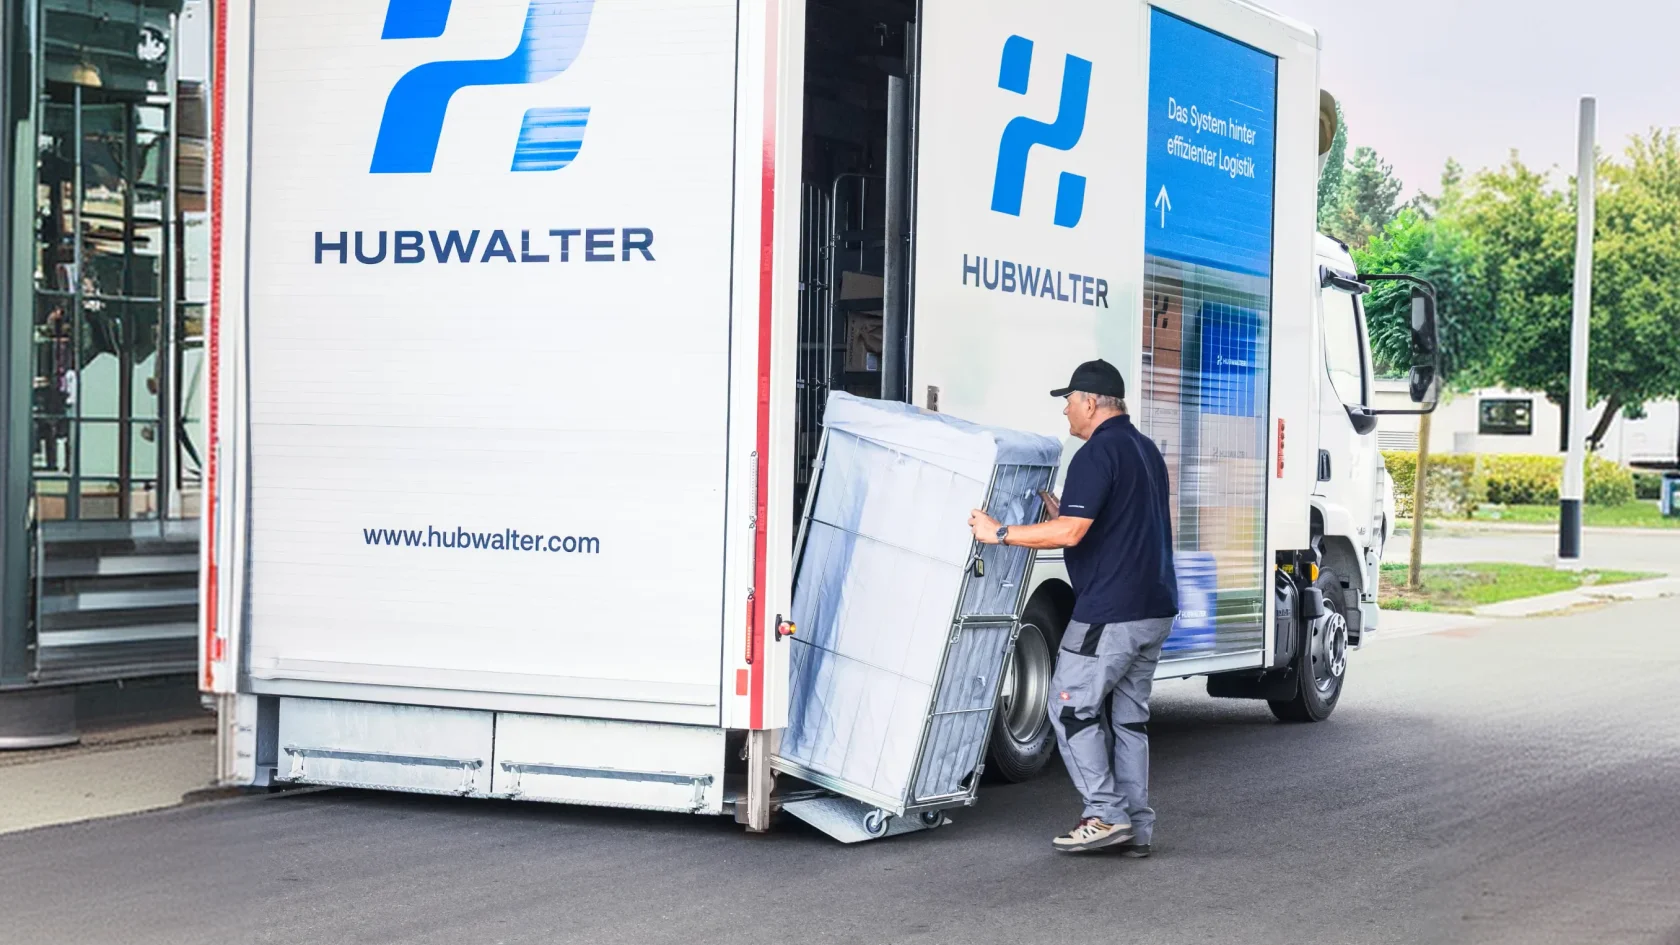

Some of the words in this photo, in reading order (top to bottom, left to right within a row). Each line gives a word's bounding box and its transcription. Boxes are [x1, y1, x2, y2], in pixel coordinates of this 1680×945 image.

[1167, 96, 1188, 124] Das
[1190, 105, 1227, 137] System
[1228, 118, 1256, 146] hinter
[1167, 135, 1217, 168] effizienter
[1218, 148, 1255, 179] Logistik
[314, 227, 656, 265] HUBWALTER
[962, 253, 1109, 309] HUBWALTER
[363, 525, 600, 554] www.hubwalter.com
